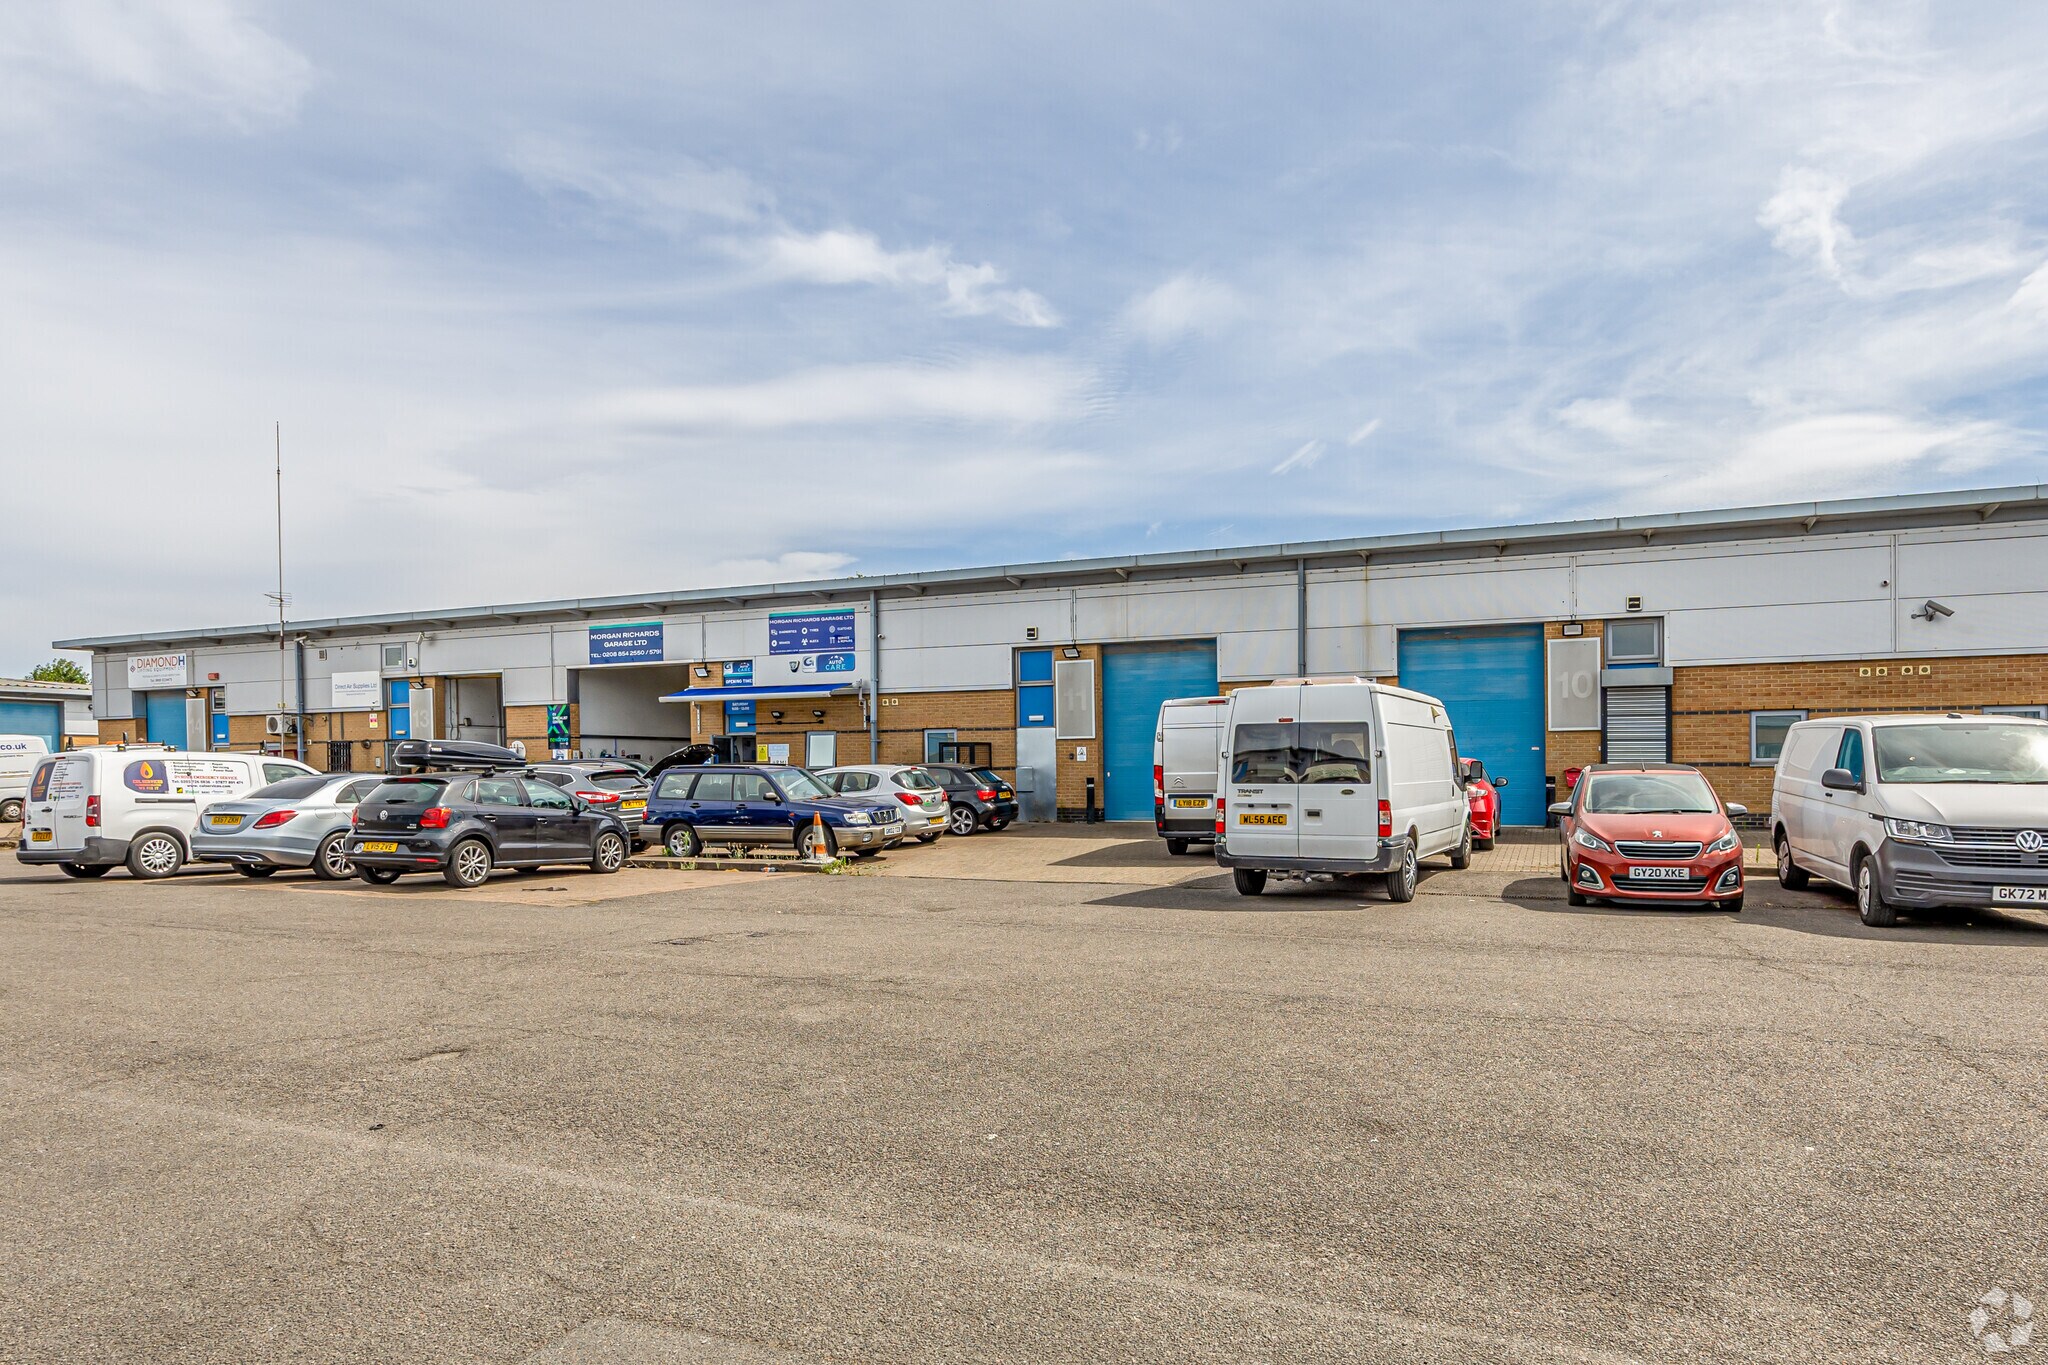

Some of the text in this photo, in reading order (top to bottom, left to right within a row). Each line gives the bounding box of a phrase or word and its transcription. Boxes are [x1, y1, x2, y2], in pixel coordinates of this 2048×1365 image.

[1556, 670, 1594, 699] 10
[1064, 687, 1087, 711] 11
[414, 710, 429, 728] 13
[1634, 868, 1685, 877] GY20 XKE
[2000, 888, 2048, 900] GK72 M
